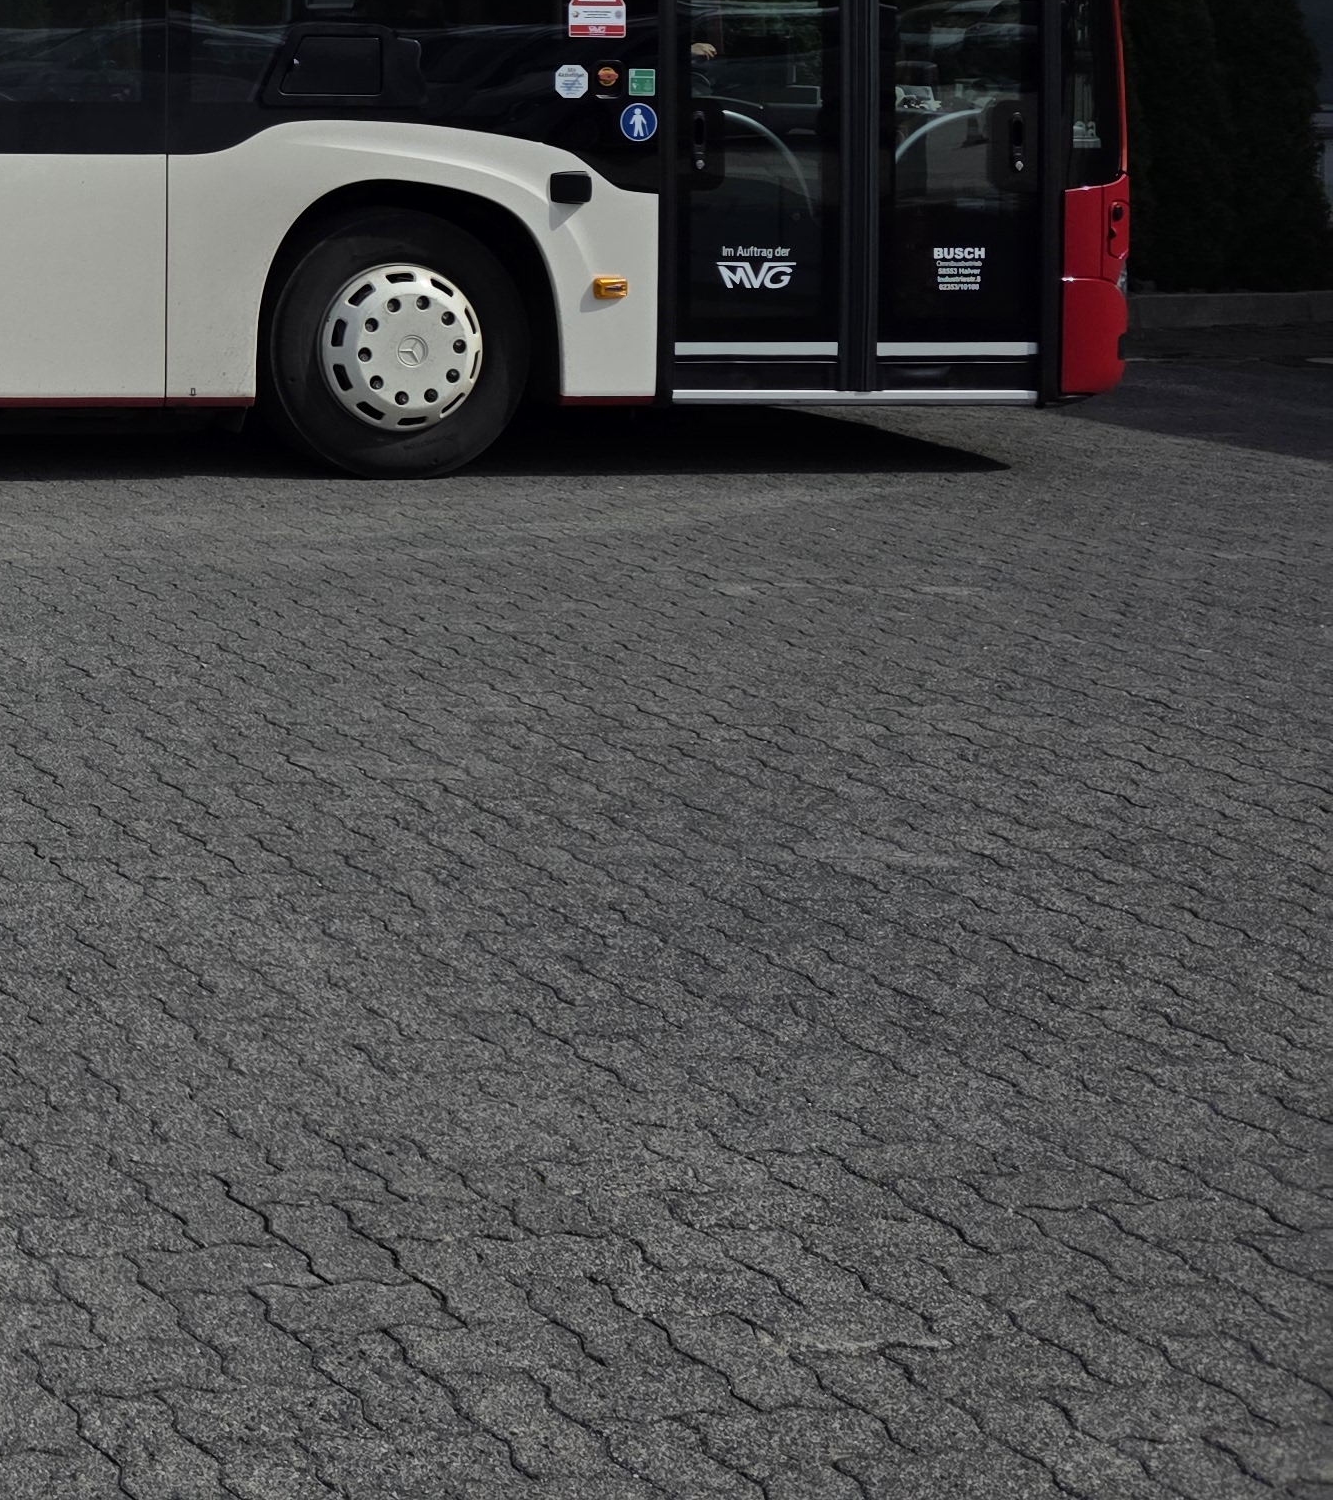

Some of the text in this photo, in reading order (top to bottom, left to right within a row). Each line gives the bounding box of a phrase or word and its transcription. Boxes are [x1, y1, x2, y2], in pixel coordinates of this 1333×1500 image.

[722, 246, 790, 258] Im Auftrag der
[933, 247, 985, 259] BUSCH
[716, 262, 796, 289] MVG
